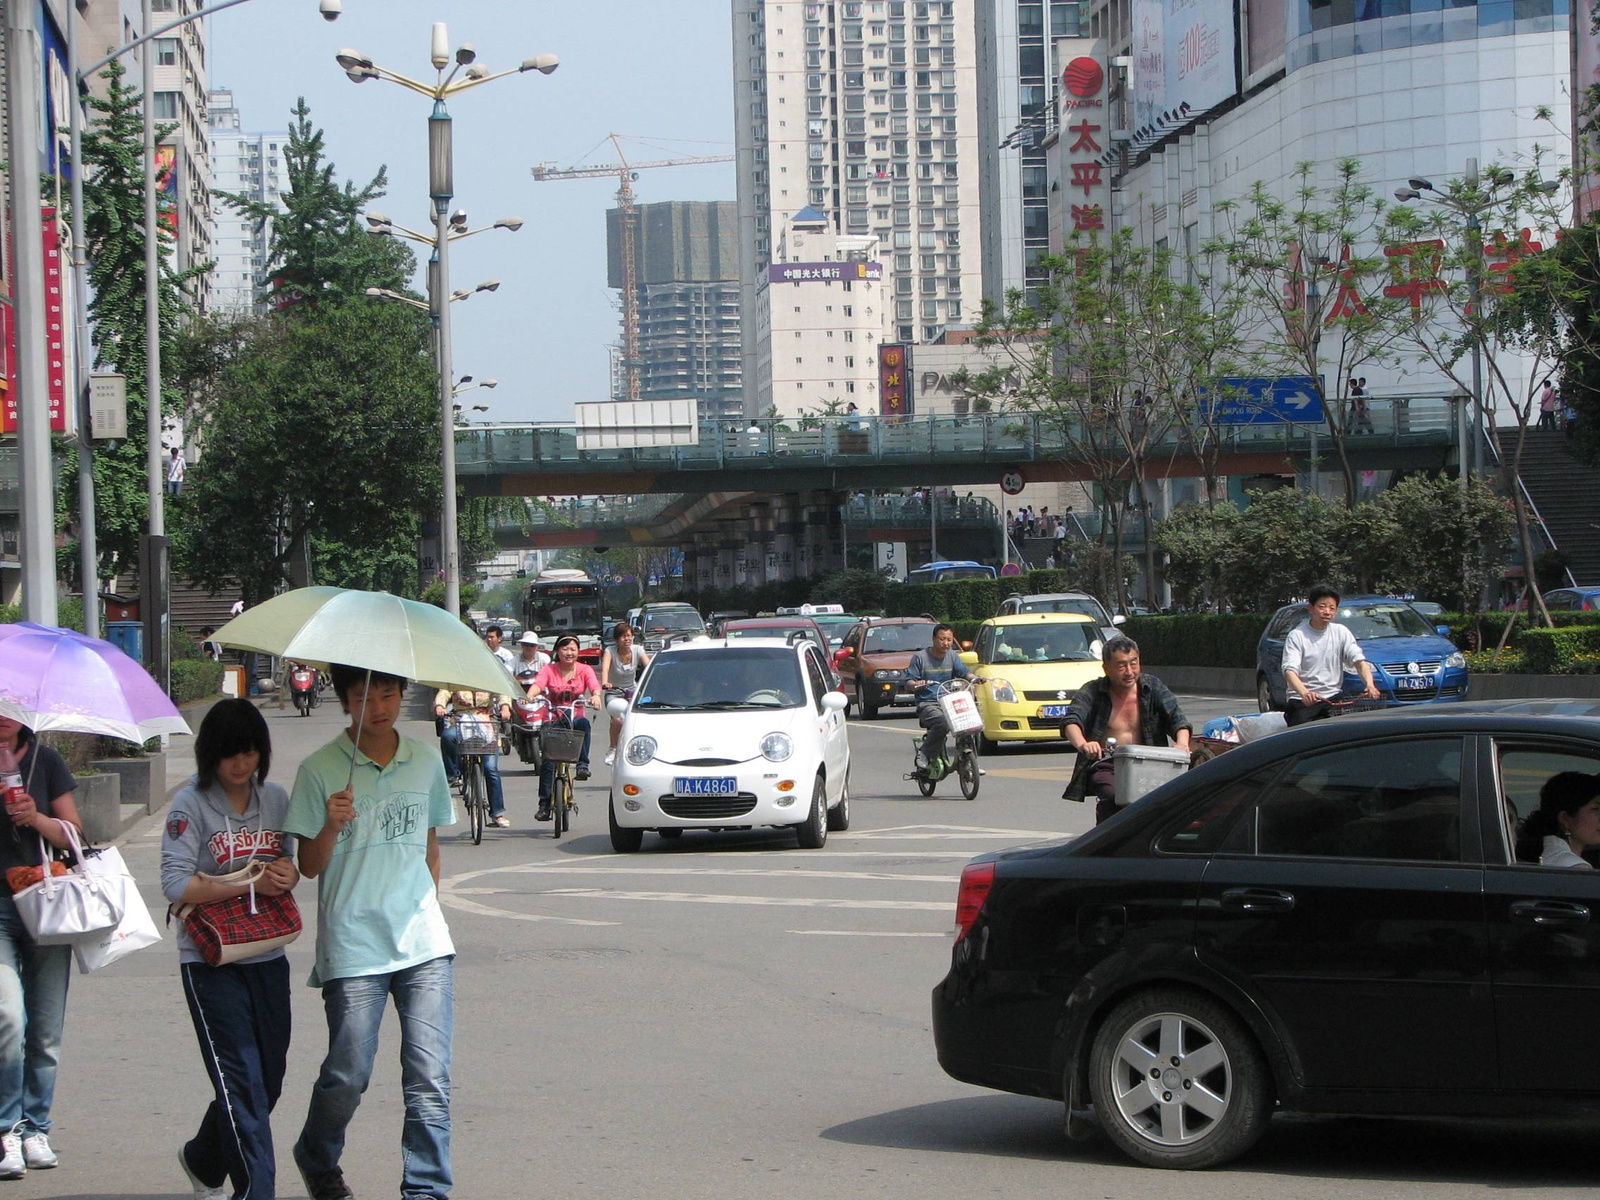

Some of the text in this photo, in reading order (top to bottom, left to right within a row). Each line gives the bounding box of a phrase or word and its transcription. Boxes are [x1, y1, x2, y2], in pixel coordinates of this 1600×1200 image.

[784, 268, 840, 279] 中国光大银行
